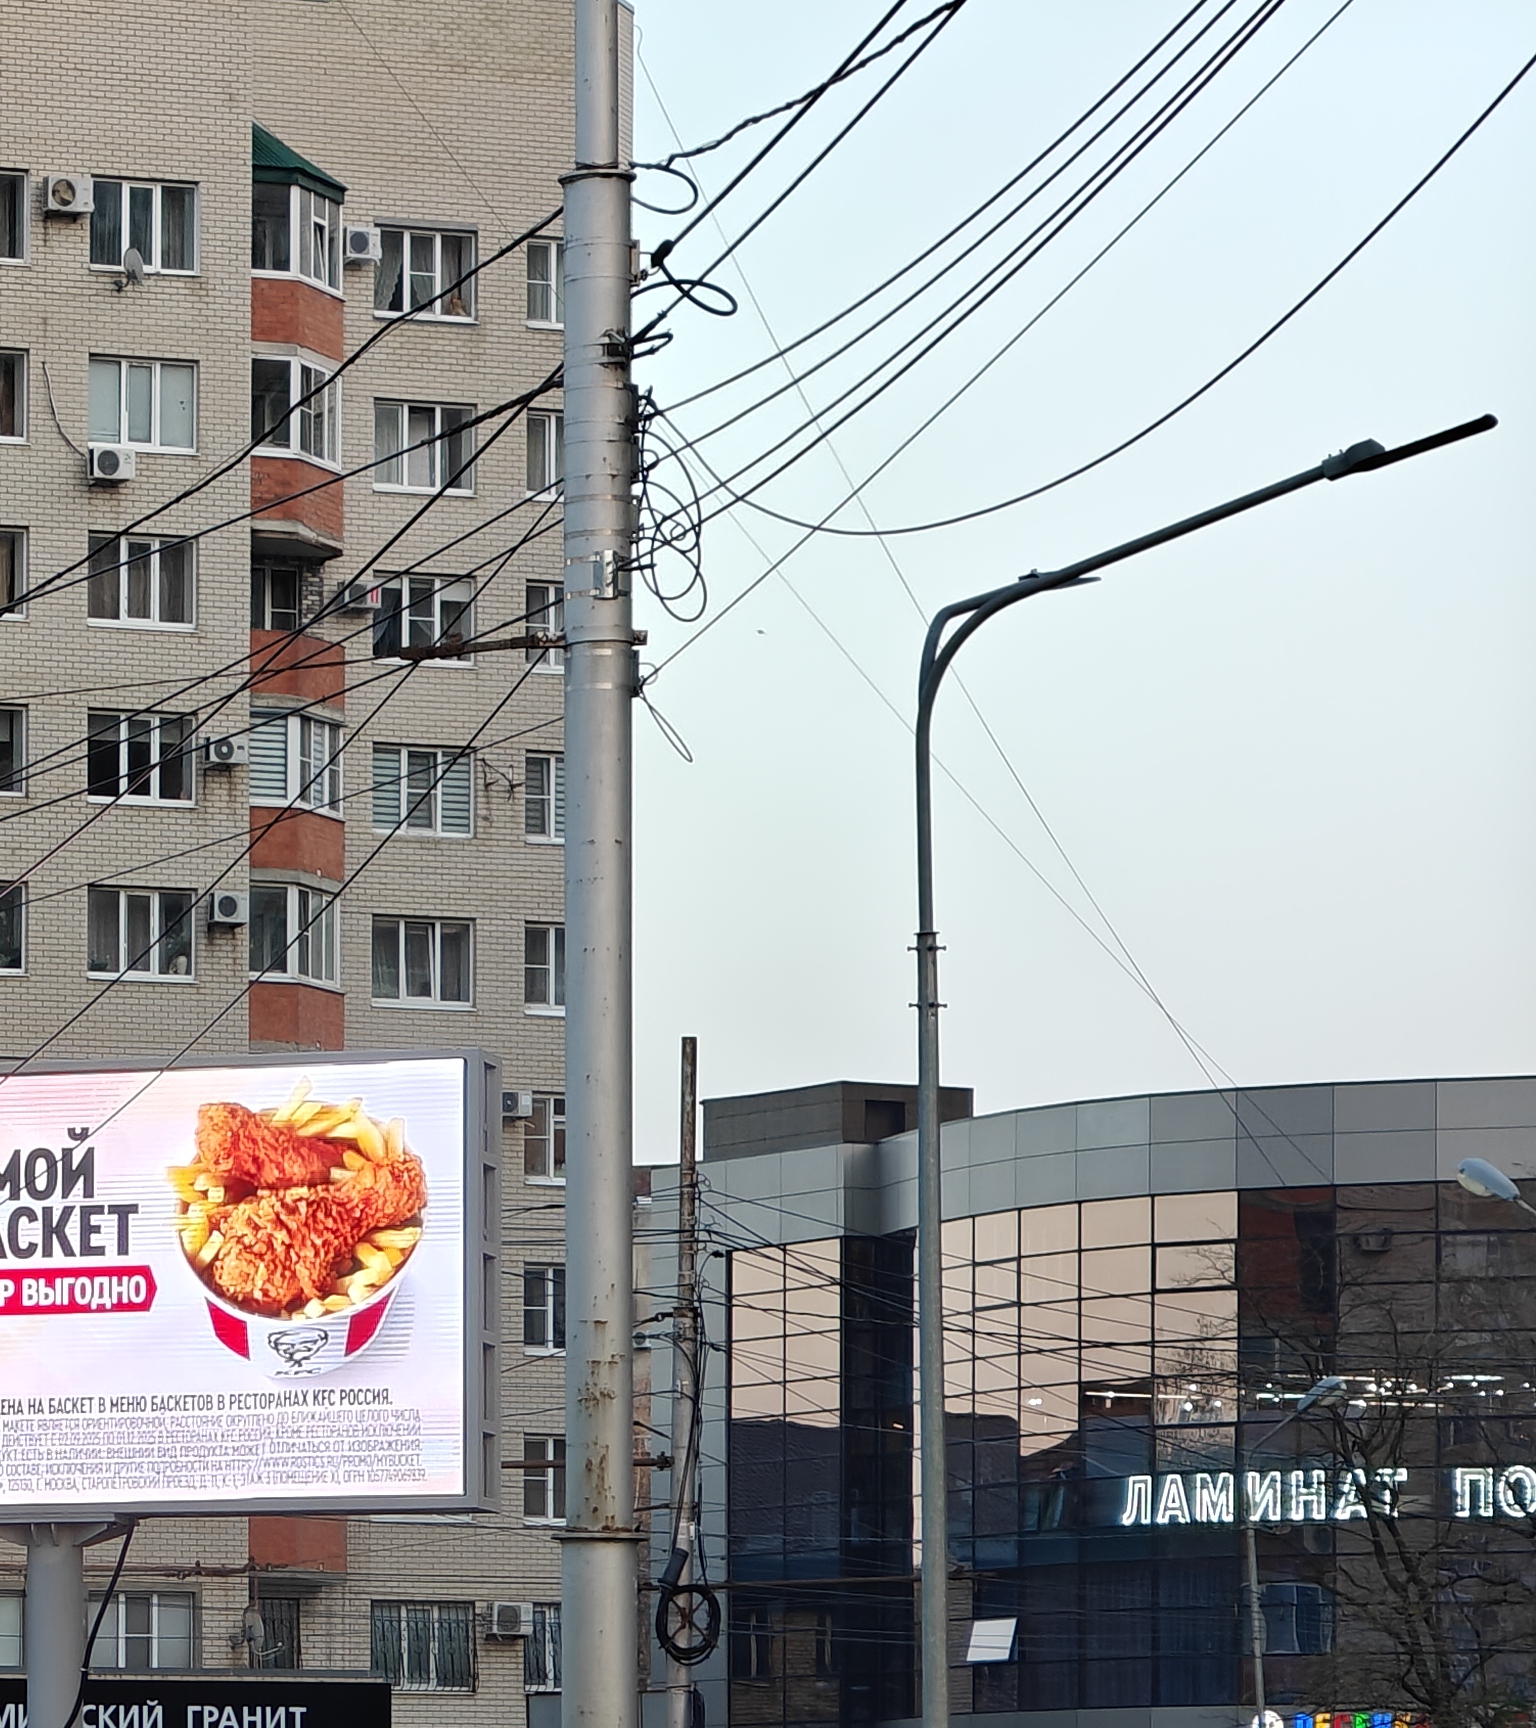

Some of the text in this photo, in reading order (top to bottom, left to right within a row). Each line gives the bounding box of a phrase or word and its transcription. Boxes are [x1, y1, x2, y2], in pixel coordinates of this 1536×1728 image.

[22, 1275, 147, 1310] ВЫГОДНО
[28, 1397, 45, 1415] НА
[48, 1396, 95, 1415] БАСКЕТ
[98, 1396, 106, 1413] В
[110, 1395, 147, 1413] МЕНЮ
[150, 1394, 214, 1413] БАСКЕТОВ
[217, 1394, 225, 1411] В
[229, 1389, 309, 1411] РЕСТОРАНАХ
[312, 1388, 336, 1406] KFC
[339, 1387, 394, 1406] РОССИЯ.
[1121, 1466, 1408, 1526] ЛАМИНАТ
